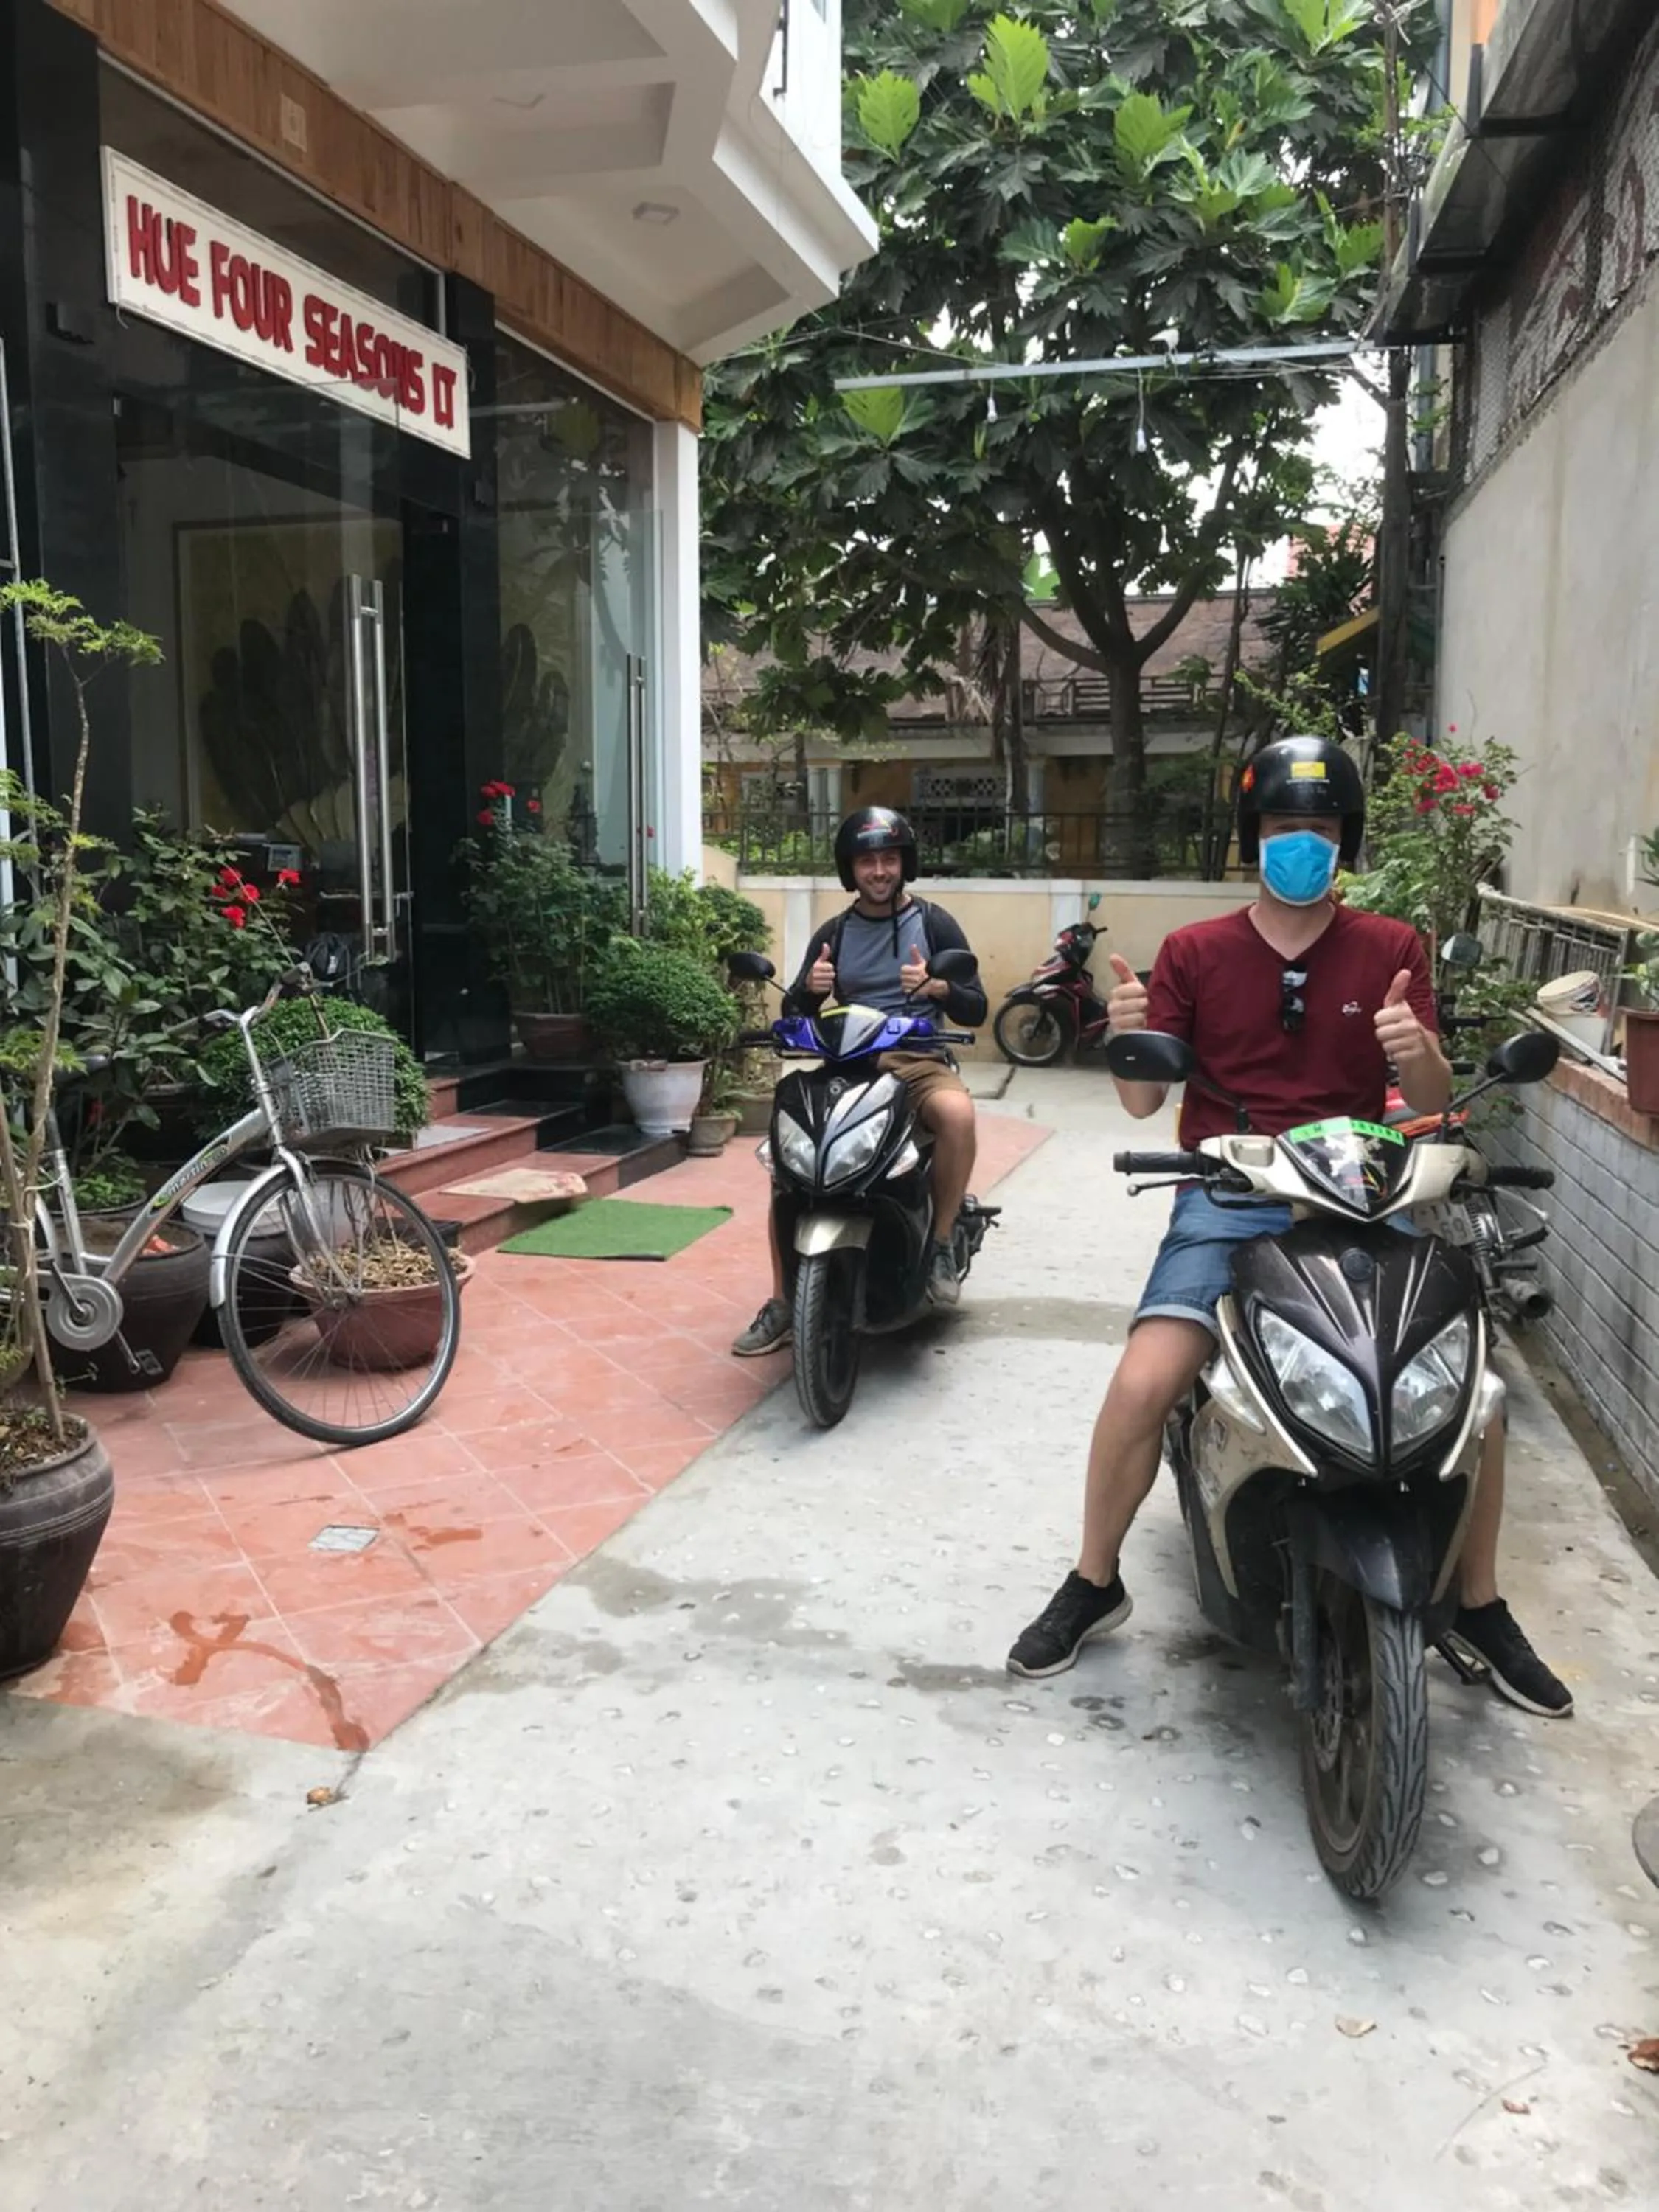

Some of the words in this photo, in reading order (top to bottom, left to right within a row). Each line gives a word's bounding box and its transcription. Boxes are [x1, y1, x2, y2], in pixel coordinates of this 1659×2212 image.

[126, 195, 201, 307] HUE
[210, 240, 295, 352] FOUR
[304, 293, 426, 414] SEASONS
